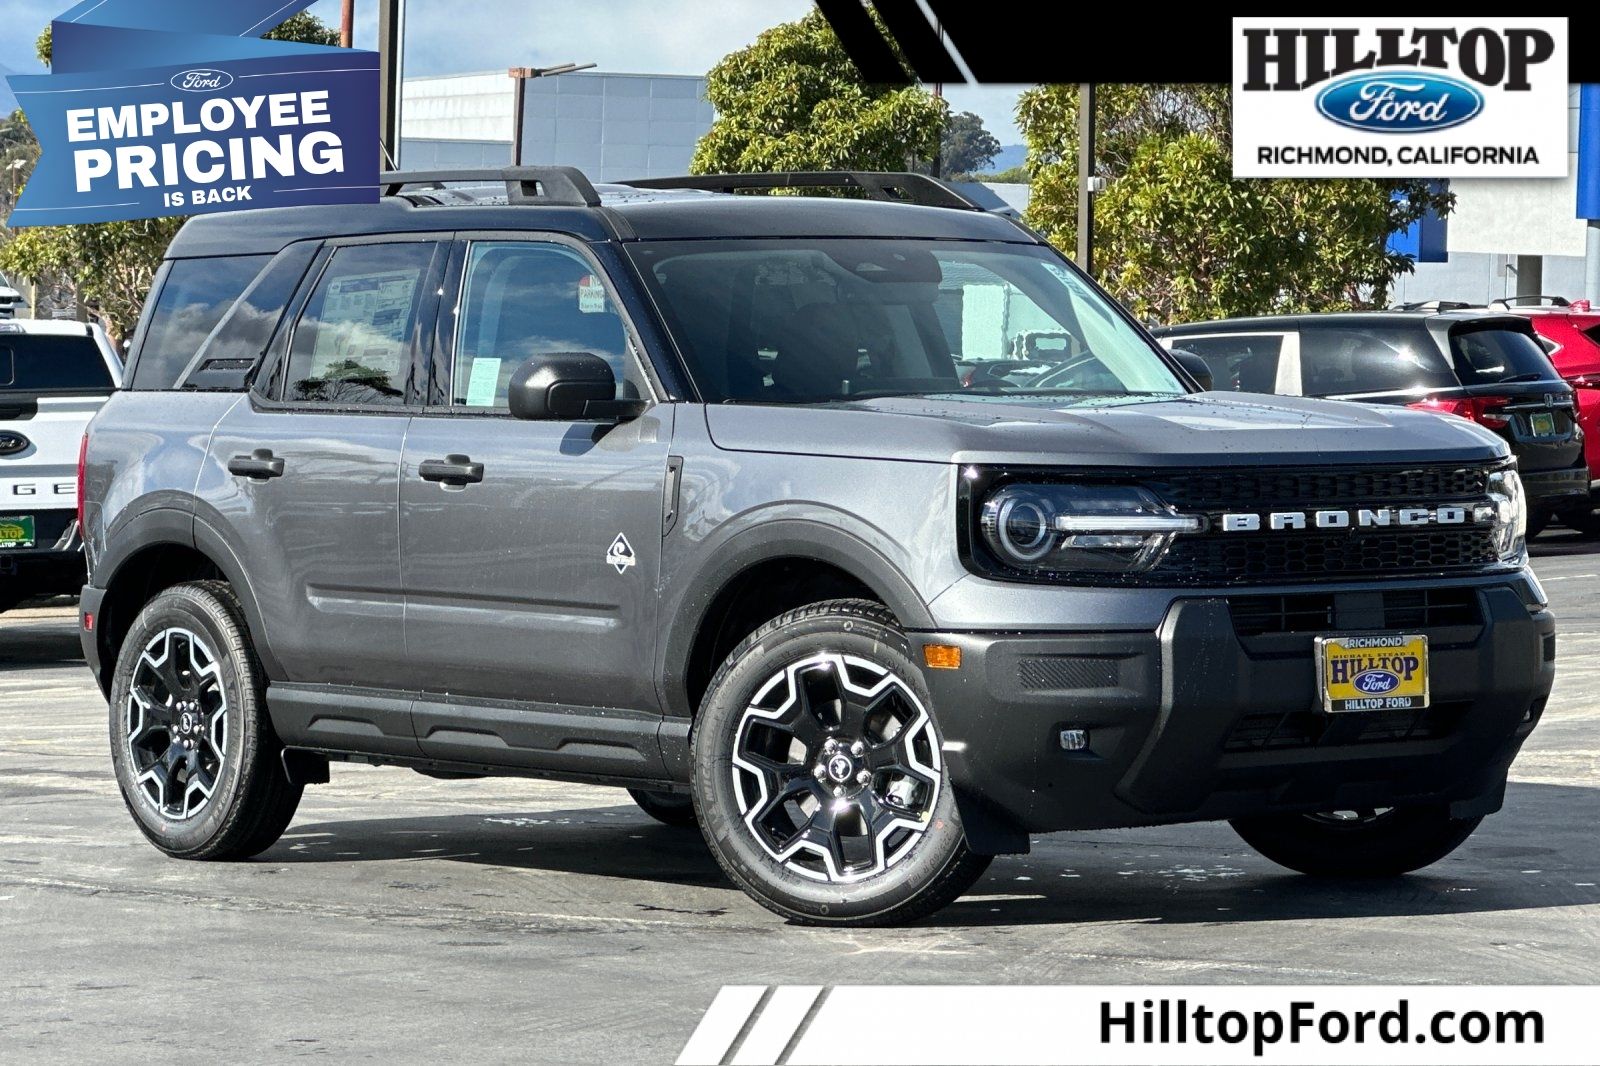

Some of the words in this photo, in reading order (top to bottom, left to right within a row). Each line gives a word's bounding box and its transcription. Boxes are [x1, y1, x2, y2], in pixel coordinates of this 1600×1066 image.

[1223, 507, 1465, 532] BRONCO
[1349, 637, 1402, 649] RICHMOND
[1331, 656, 1419, 684] HILLTOP
[1362, 673, 1391, 691] Ford
[1345, 698, 1383, 710] HILLTOP
[1386, 696, 1412, 708] FORD
